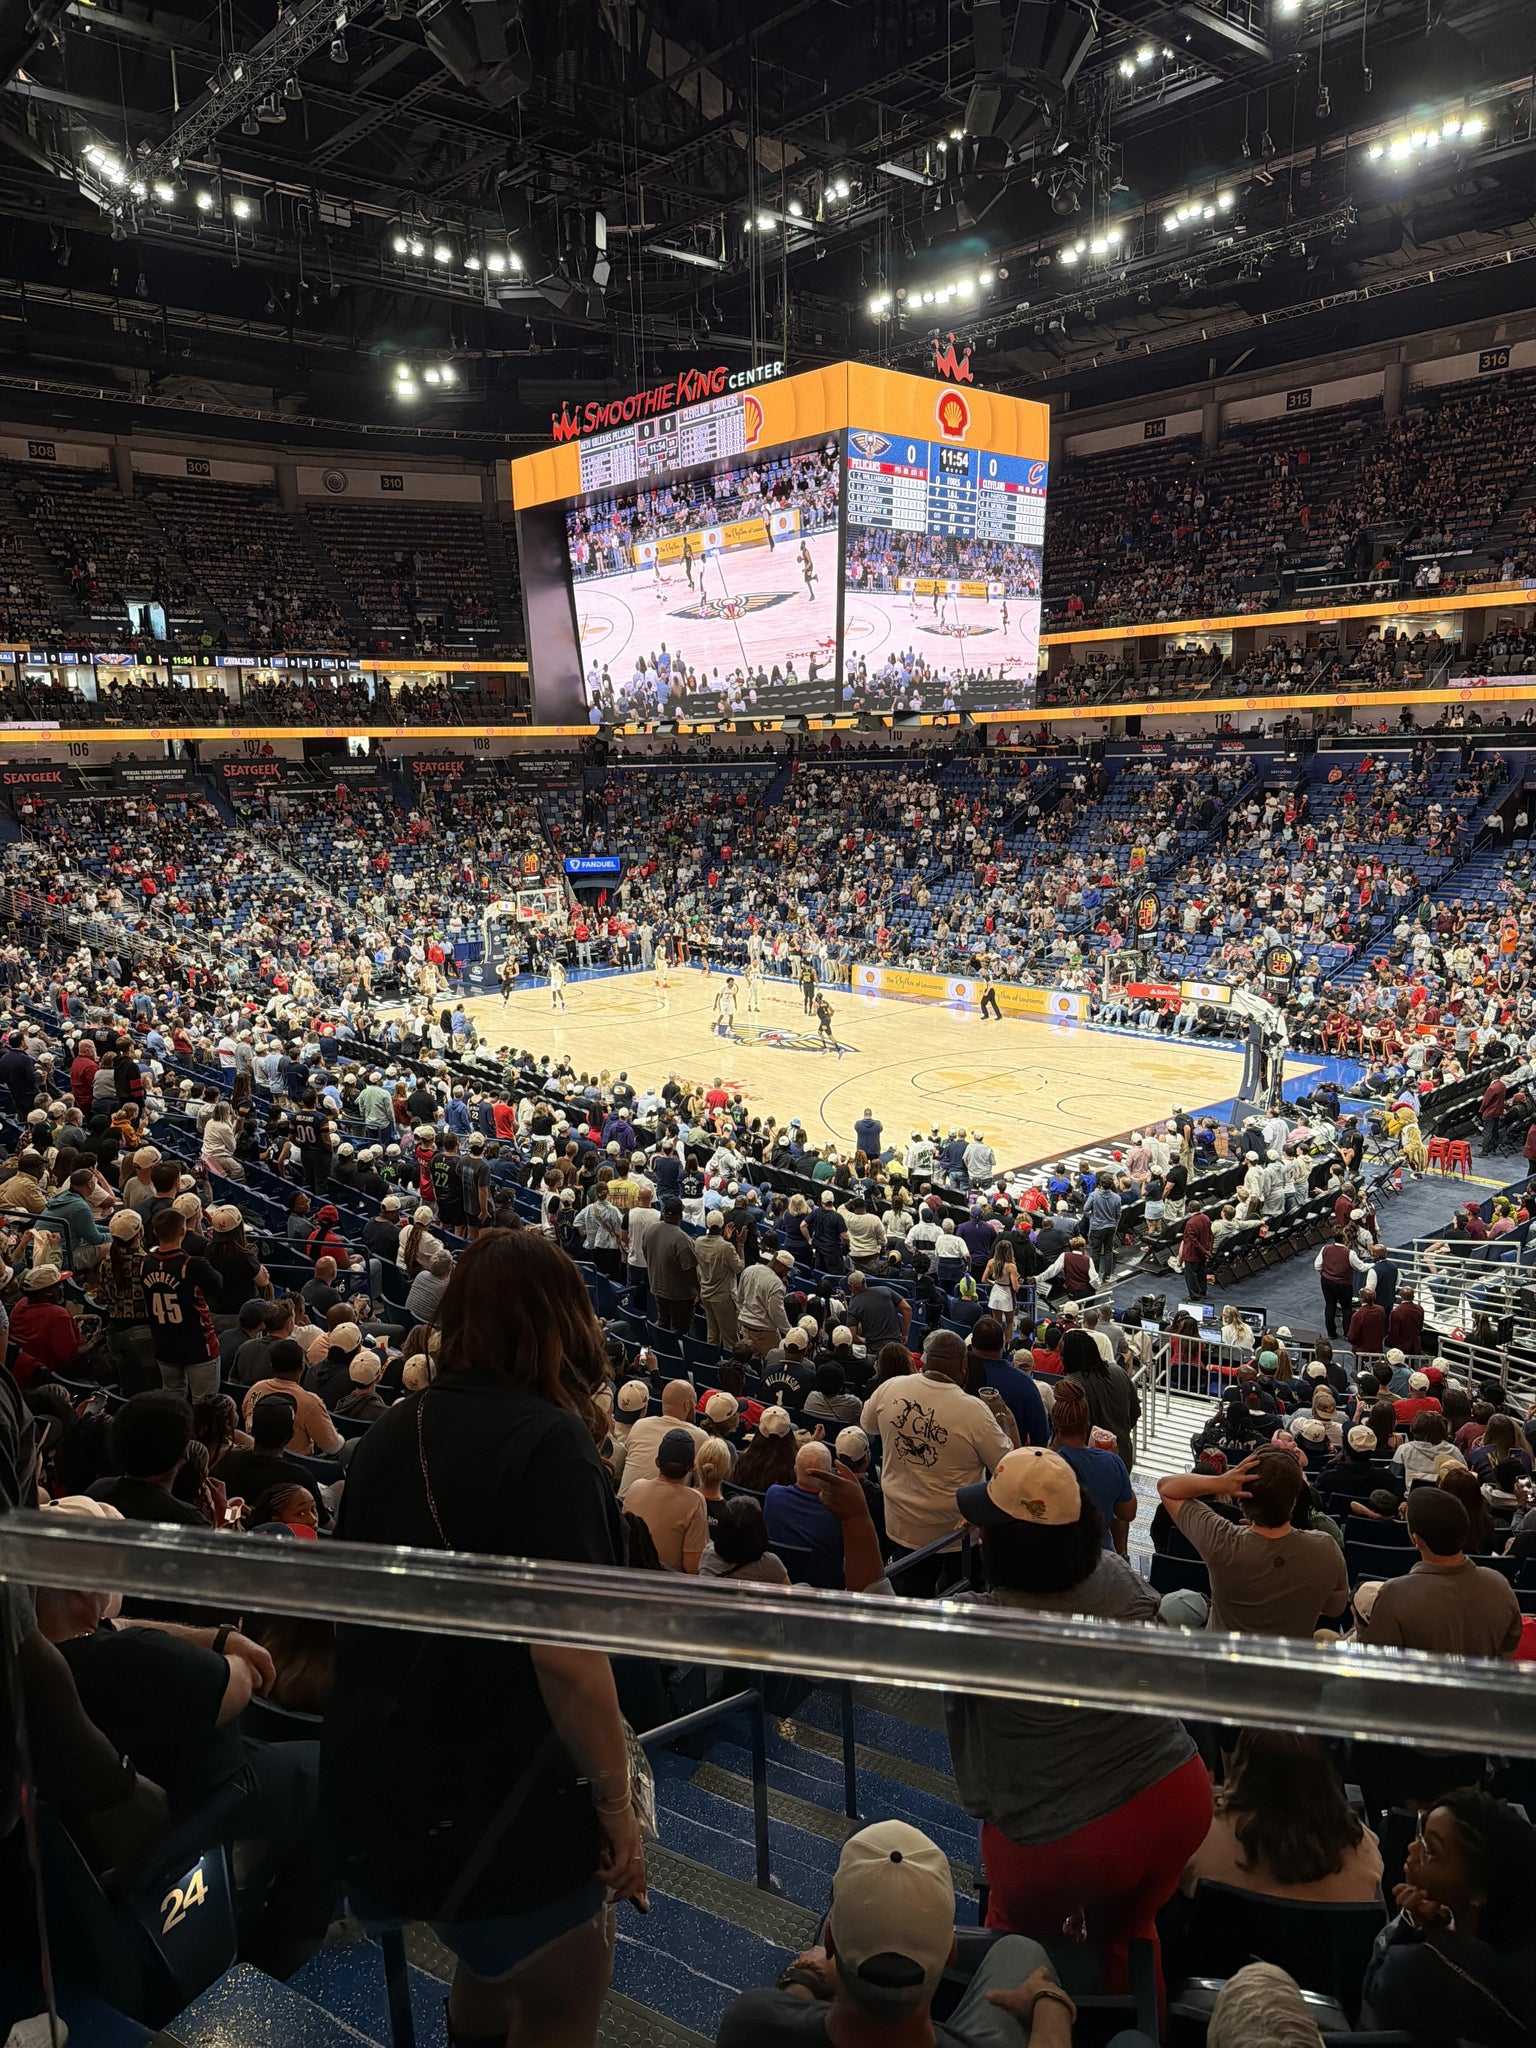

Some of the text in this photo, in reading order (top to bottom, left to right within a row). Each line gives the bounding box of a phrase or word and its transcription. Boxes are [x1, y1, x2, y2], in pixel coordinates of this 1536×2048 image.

[1482, 353, 1508, 369] 316
[583, 383, 675, 434] SMOOTHIE
[729, 360, 784, 390] CENTER
[1287, 393, 1311, 408] 315
[682, 396, 740, 421] CLEVELAND CAVALIERS
[644, 425, 650, 437] 0
[665, 419, 671, 431] 0
[1145, 423, 1164, 437] 314
[612, 427, 635, 442] PELICANS
[29, 445, 54, 458] 308
[649, 439, 666, 452] 11:54
[907, 445, 916, 464] 0
[941, 448, 969, 468] 11:54
[187, 461, 210, 474] 309
[851, 458, 881, 472] PELICANS
[989, 459, 998, 477] 0
[382, 476, 402, 489] 310
[982, 479, 1006, 492] CLEVELAND
[51, 654, 56, 662] 0
[146, 655, 152, 664] 0
[172, 656, 193, 664] 11:54
[203, 656, 210, 666] 0
[223, 657, 255, 666] CAVALIERS
[67, 742, 90, 757] 106
[242, 740, 260, 754] 107
[473, 737, 491, 751] 108
[223, 763, 280, 778] SEATGEEK
[412, 761, 466, 773] SEATGEEK
[3, 771, 63, 785] SEATGEEK
[524, 861, 538, 873] 20
[581, 860, 616, 868] FANDUEL
[1138, 909, 1153, 927] 20
[1272, 961, 1287, 973] 20
[886, 976, 895, 984] The
[895, 973, 914, 993] Rhythm
[921, 981, 944, 991] Louisiana
[1018, 994, 1045, 1006] Louisiana
[296, 1124, 317, 1144] 00
[434, 1161, 450, 1172] GREEN
[434, 1170, 449, 1189] 22
[143, 1271, 181, 1290] MITCHELL
[152, 1292, 183, 1324] 45
[765, 1372, 801, 1392] WILLIAMSON
[775, 1390, 784, 1406] 1
[160, 1868, 209, 1935] 24
